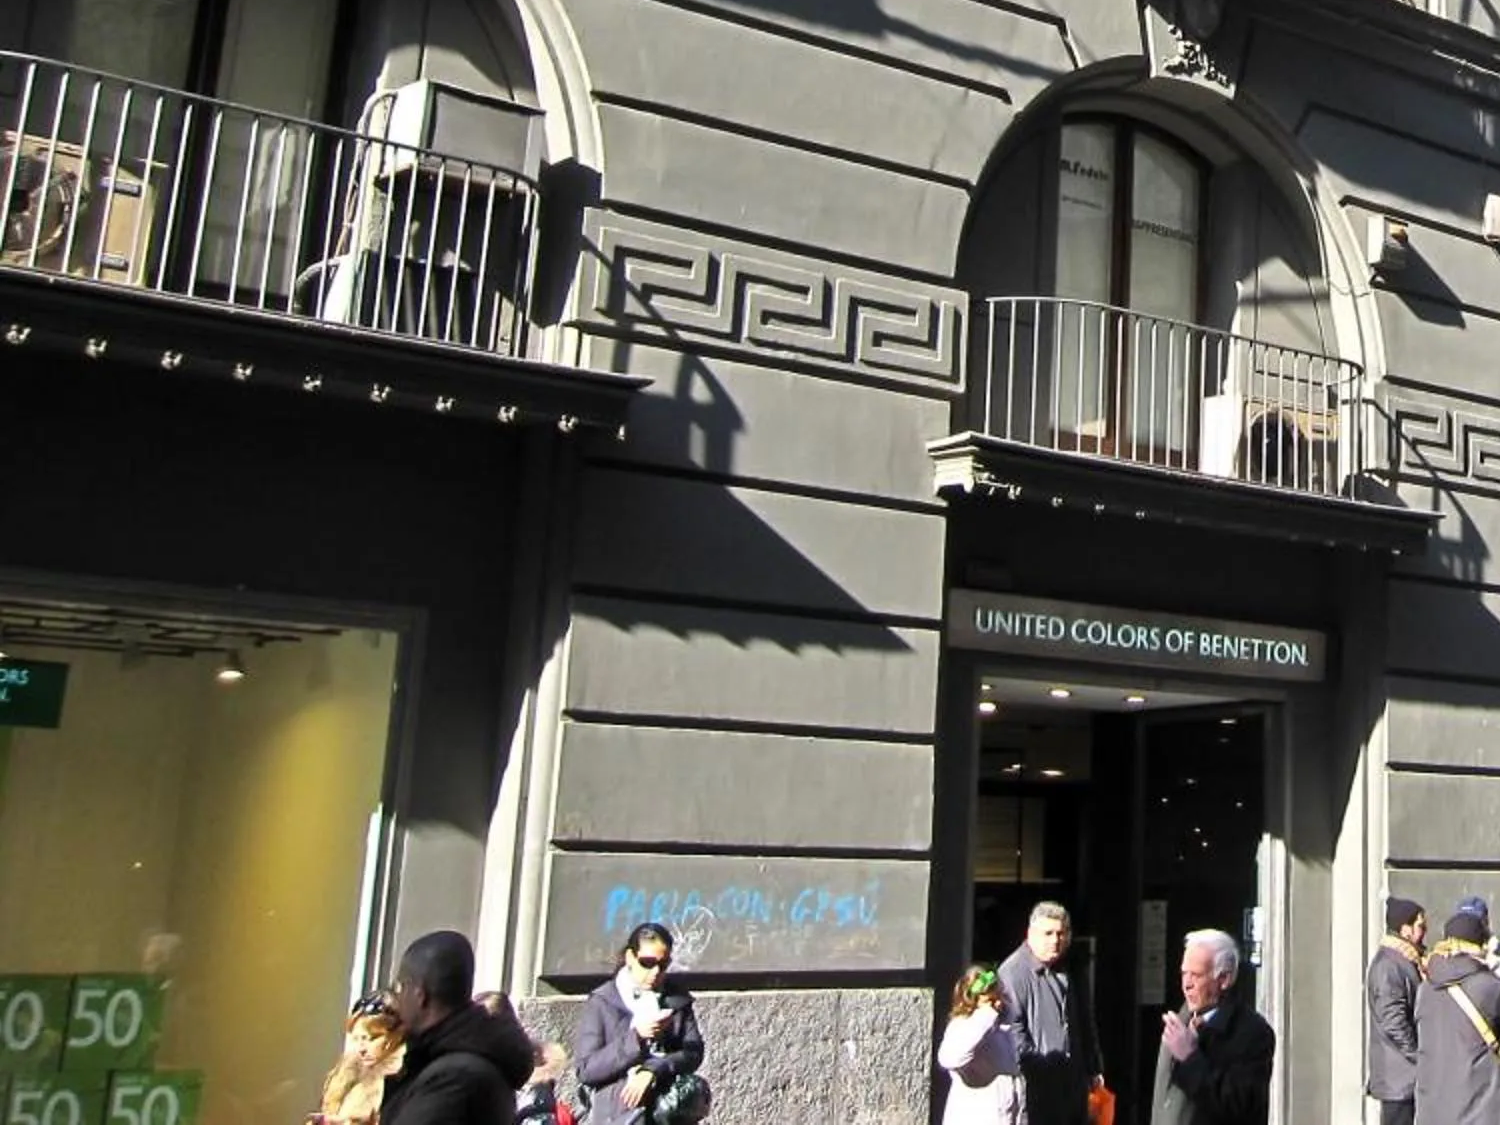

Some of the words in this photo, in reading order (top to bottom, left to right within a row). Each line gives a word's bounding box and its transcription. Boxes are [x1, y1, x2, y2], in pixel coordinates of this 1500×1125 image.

[975, 607, 1064, 641] UNITED
[1071, 619, 1160, 651] COLORS
[1165, 628, 1195, 653] OF
[67, 988, 142, 1048] 50
